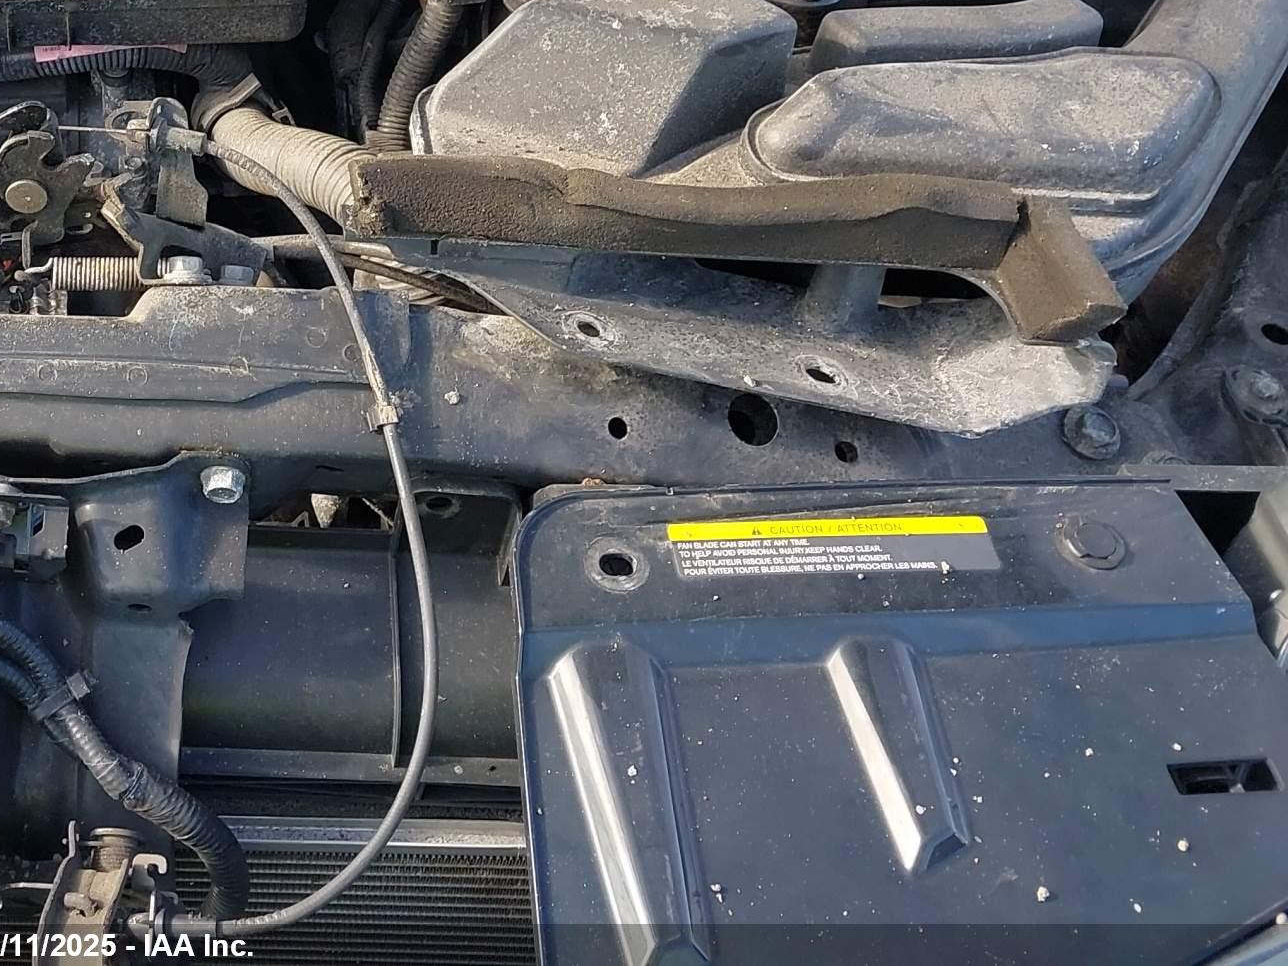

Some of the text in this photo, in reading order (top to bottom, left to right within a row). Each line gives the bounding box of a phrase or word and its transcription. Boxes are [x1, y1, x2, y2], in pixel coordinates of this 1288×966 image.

[769, 524, 824, 536] CAUTION
[837, 522, 903, 533] ATTENTION
[694, 541, 719, 549] BLADE
[720, 540, 737, 548] CAN
[738, 539, 761, 547] START
[773, 538, 789, 546] ANY
[679, 550, 691, 558] TO
[692, 549, 712, 558] HELP
[712, 549, 737, 557] AVOID
[737, 547, 778, 556] PERSONAL
[826, 545, 854, 553] HANDS
[693, 558, 742, 567] VENTILATEUR
[743, 557, 772, 566] RISQUE
[773, 556, 785, 564] DE
[785, 554, 828, 564] DÉMARRER
[857, 554, 893, 562] MOMENT.
[684, 568, 707, 576] POUR
[734, 566, 760, 574] TOUTE
[804, 564, 816, 572] NE
[833, 563, 845, 571] EN
[846, 563, 894, 571] APPROCHER
